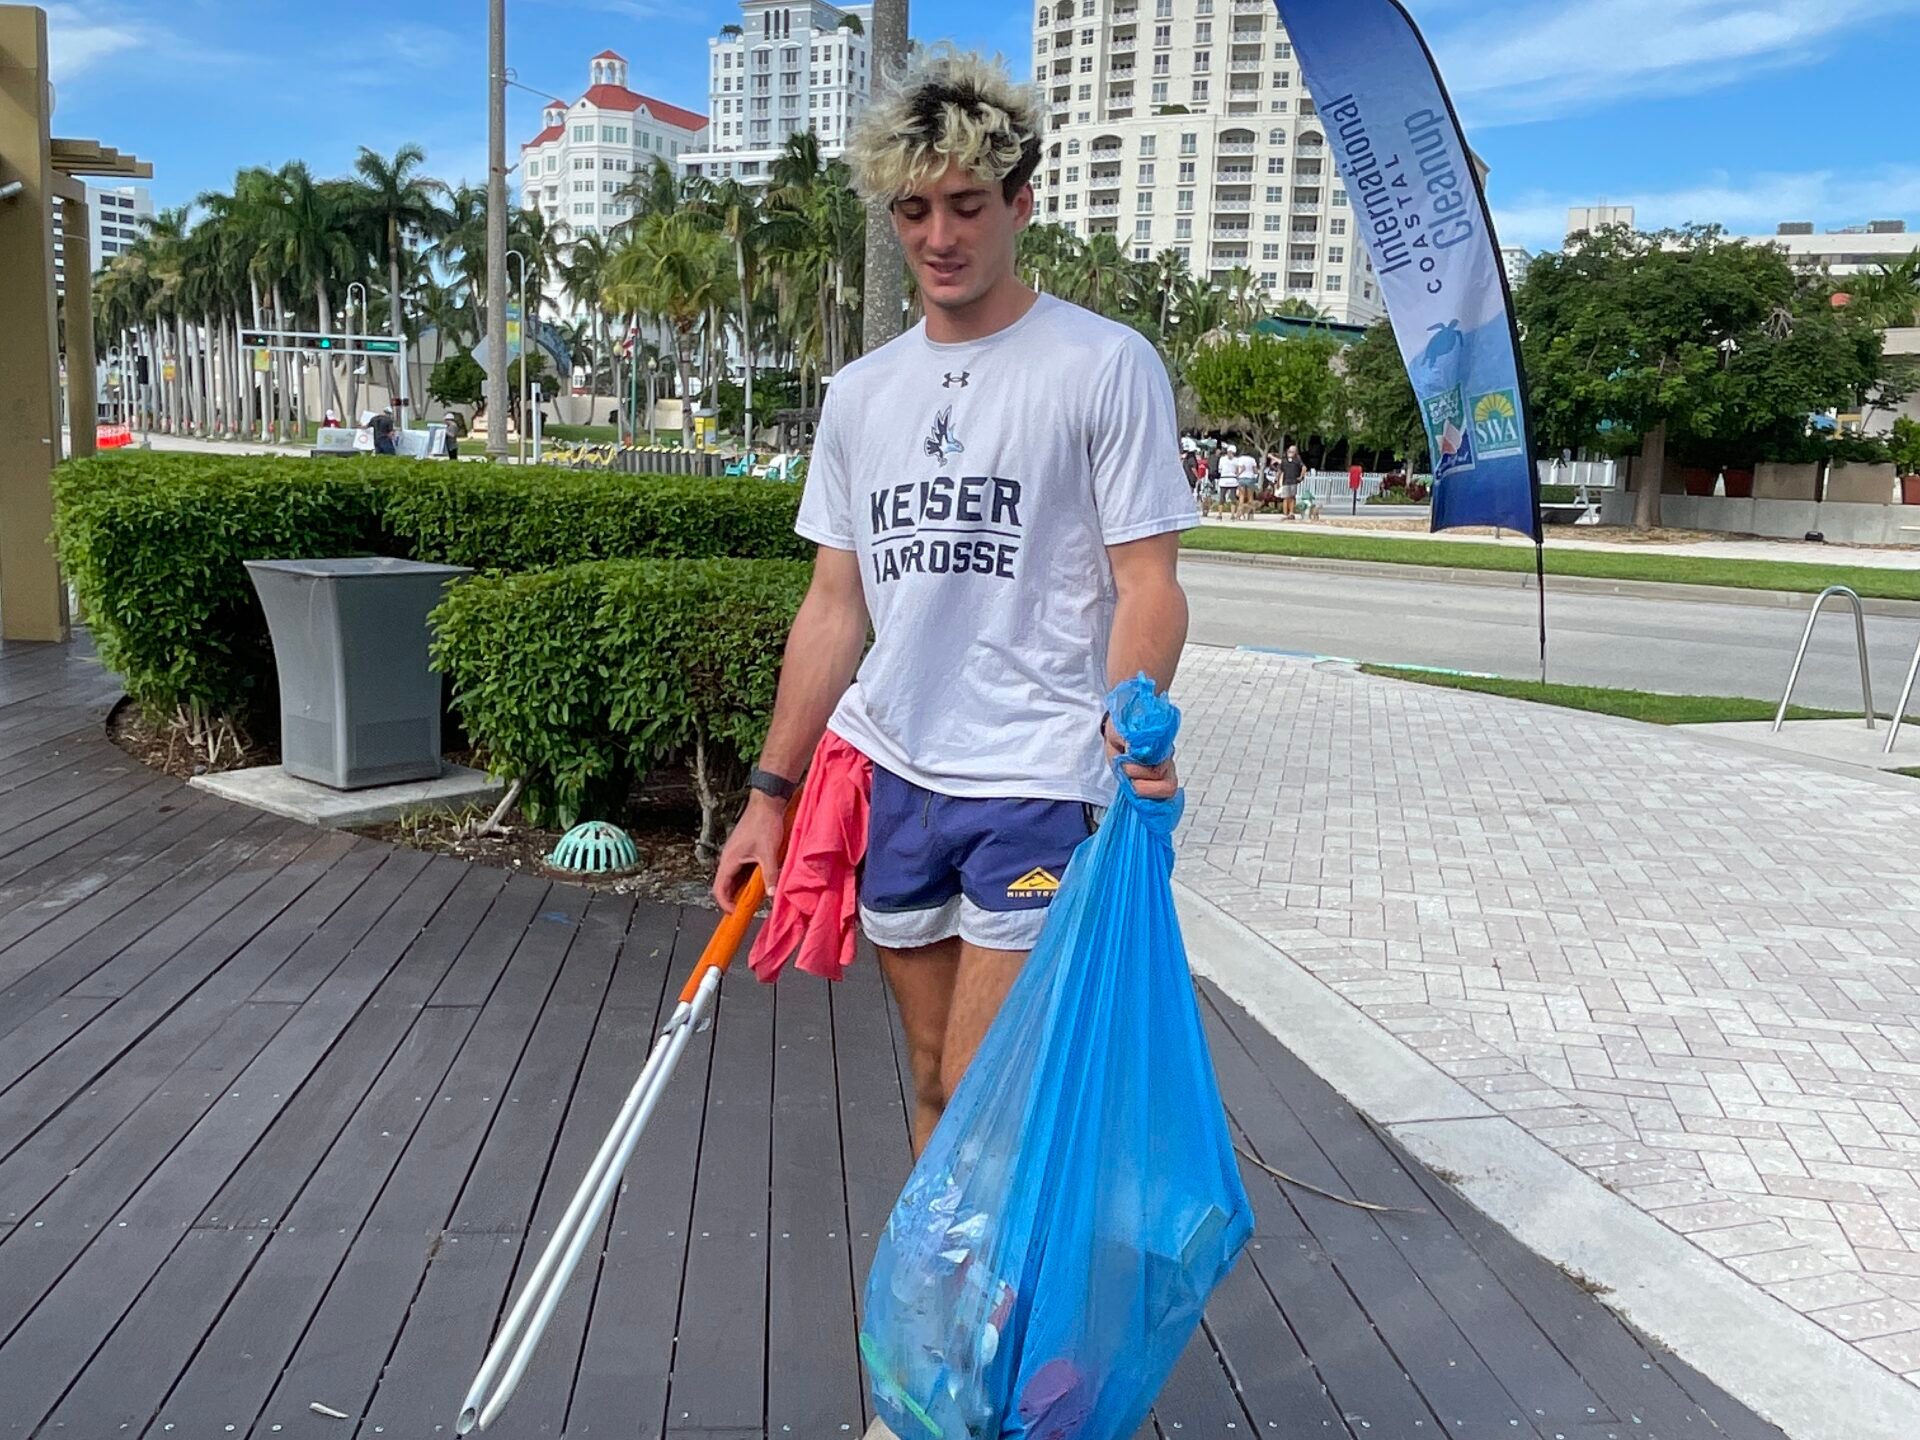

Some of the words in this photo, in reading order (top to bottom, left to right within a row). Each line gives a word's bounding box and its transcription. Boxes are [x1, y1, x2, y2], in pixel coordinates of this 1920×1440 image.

[1321, 93, 1412, 275] International
[1386, 154, 1443, 294] COASTAL
[1404, 108, 1474, 250] Cleanup
[1476, 417, 1518, 444] SWA
[871, 476, 1023, 535] KEISER
